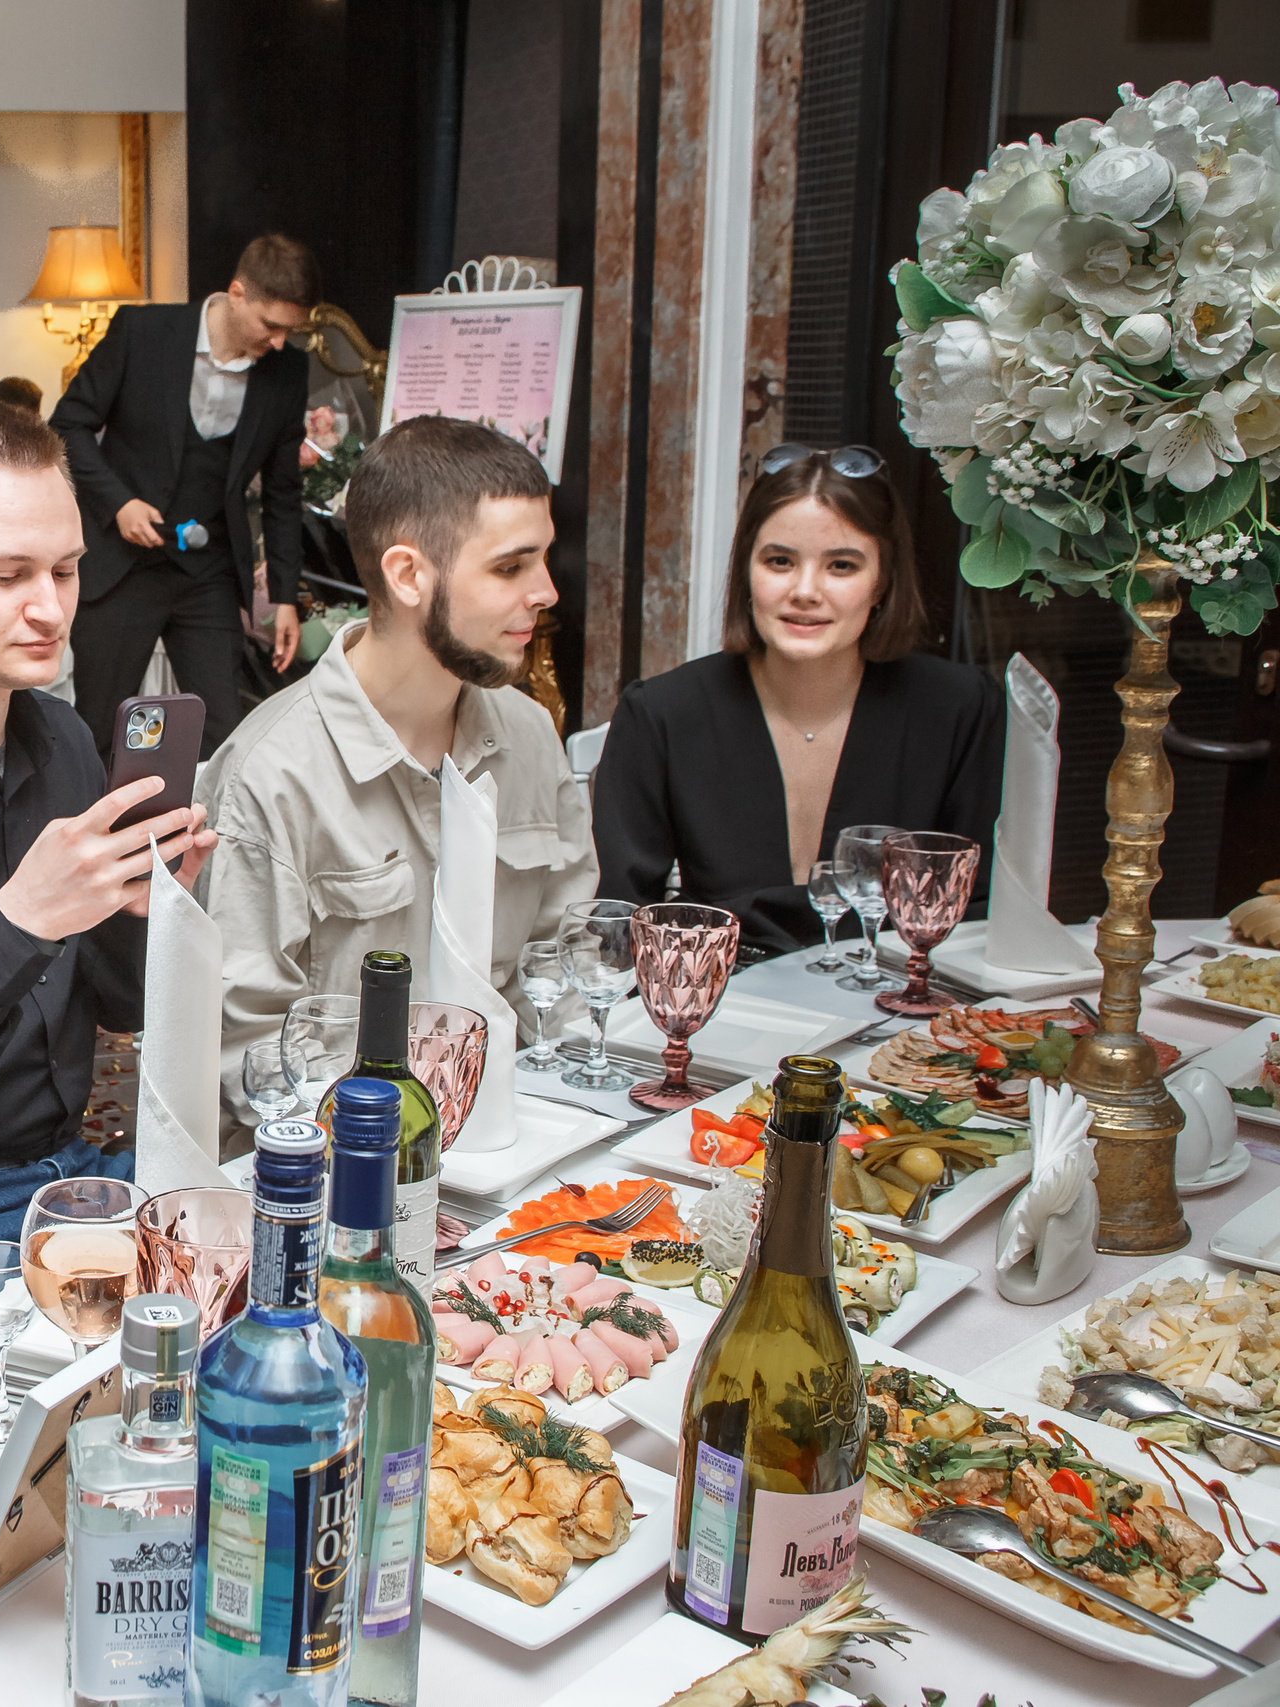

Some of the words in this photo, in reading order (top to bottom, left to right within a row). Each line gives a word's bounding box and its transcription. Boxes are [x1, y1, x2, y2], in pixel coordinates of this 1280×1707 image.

[153, 1394, 179, 1403] WORLD
[153, 1401, 178, 1413] GIN
[153, 1411, 178, 1419] AWARDS
[700, 1454, 737, 1476] ФЕДЕРАЦИЯ
[701, 1448, 737, 1470] РОССИЙСКАЯ
[697, 1475, 736, 1498] ФЕДЕРАЛЬНАЯ
[393, 1497, 412, 1507] МАРКА
[705, 1490, 723, 1504] МАРКА
[224, 1503, 247, 1517] МАРКА
[780, 1541, 828, 1578] Левъ
[95, 1579, 191, 1614] BARRIS
[114, 1617, 163, 1634] DRY
[124, 1632, 169, 1641] MASTERLY
